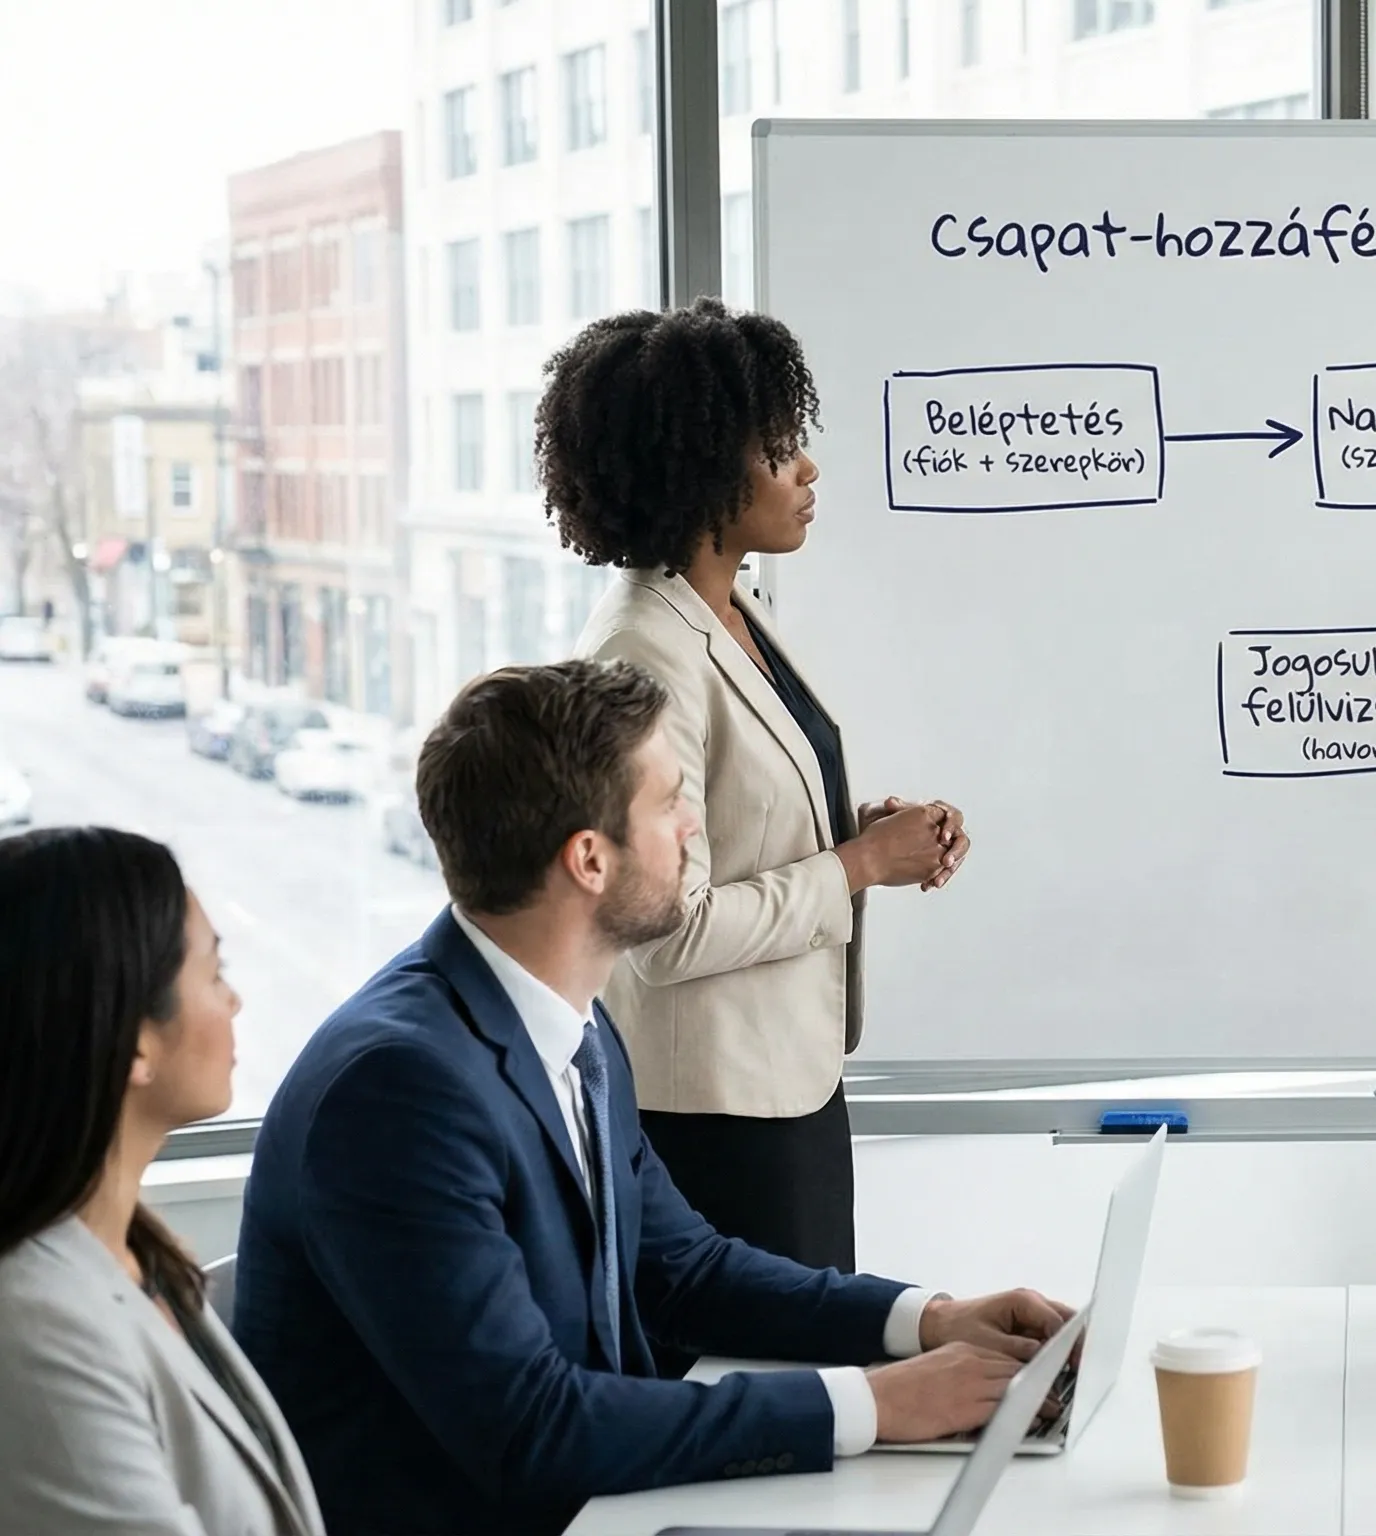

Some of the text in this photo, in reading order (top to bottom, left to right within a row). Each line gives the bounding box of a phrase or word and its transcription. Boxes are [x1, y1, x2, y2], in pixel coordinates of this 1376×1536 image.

[926, 399, 1123, 447] Beléptetés
[903, 444, 1145, 481] (fiók + szerepkör)
